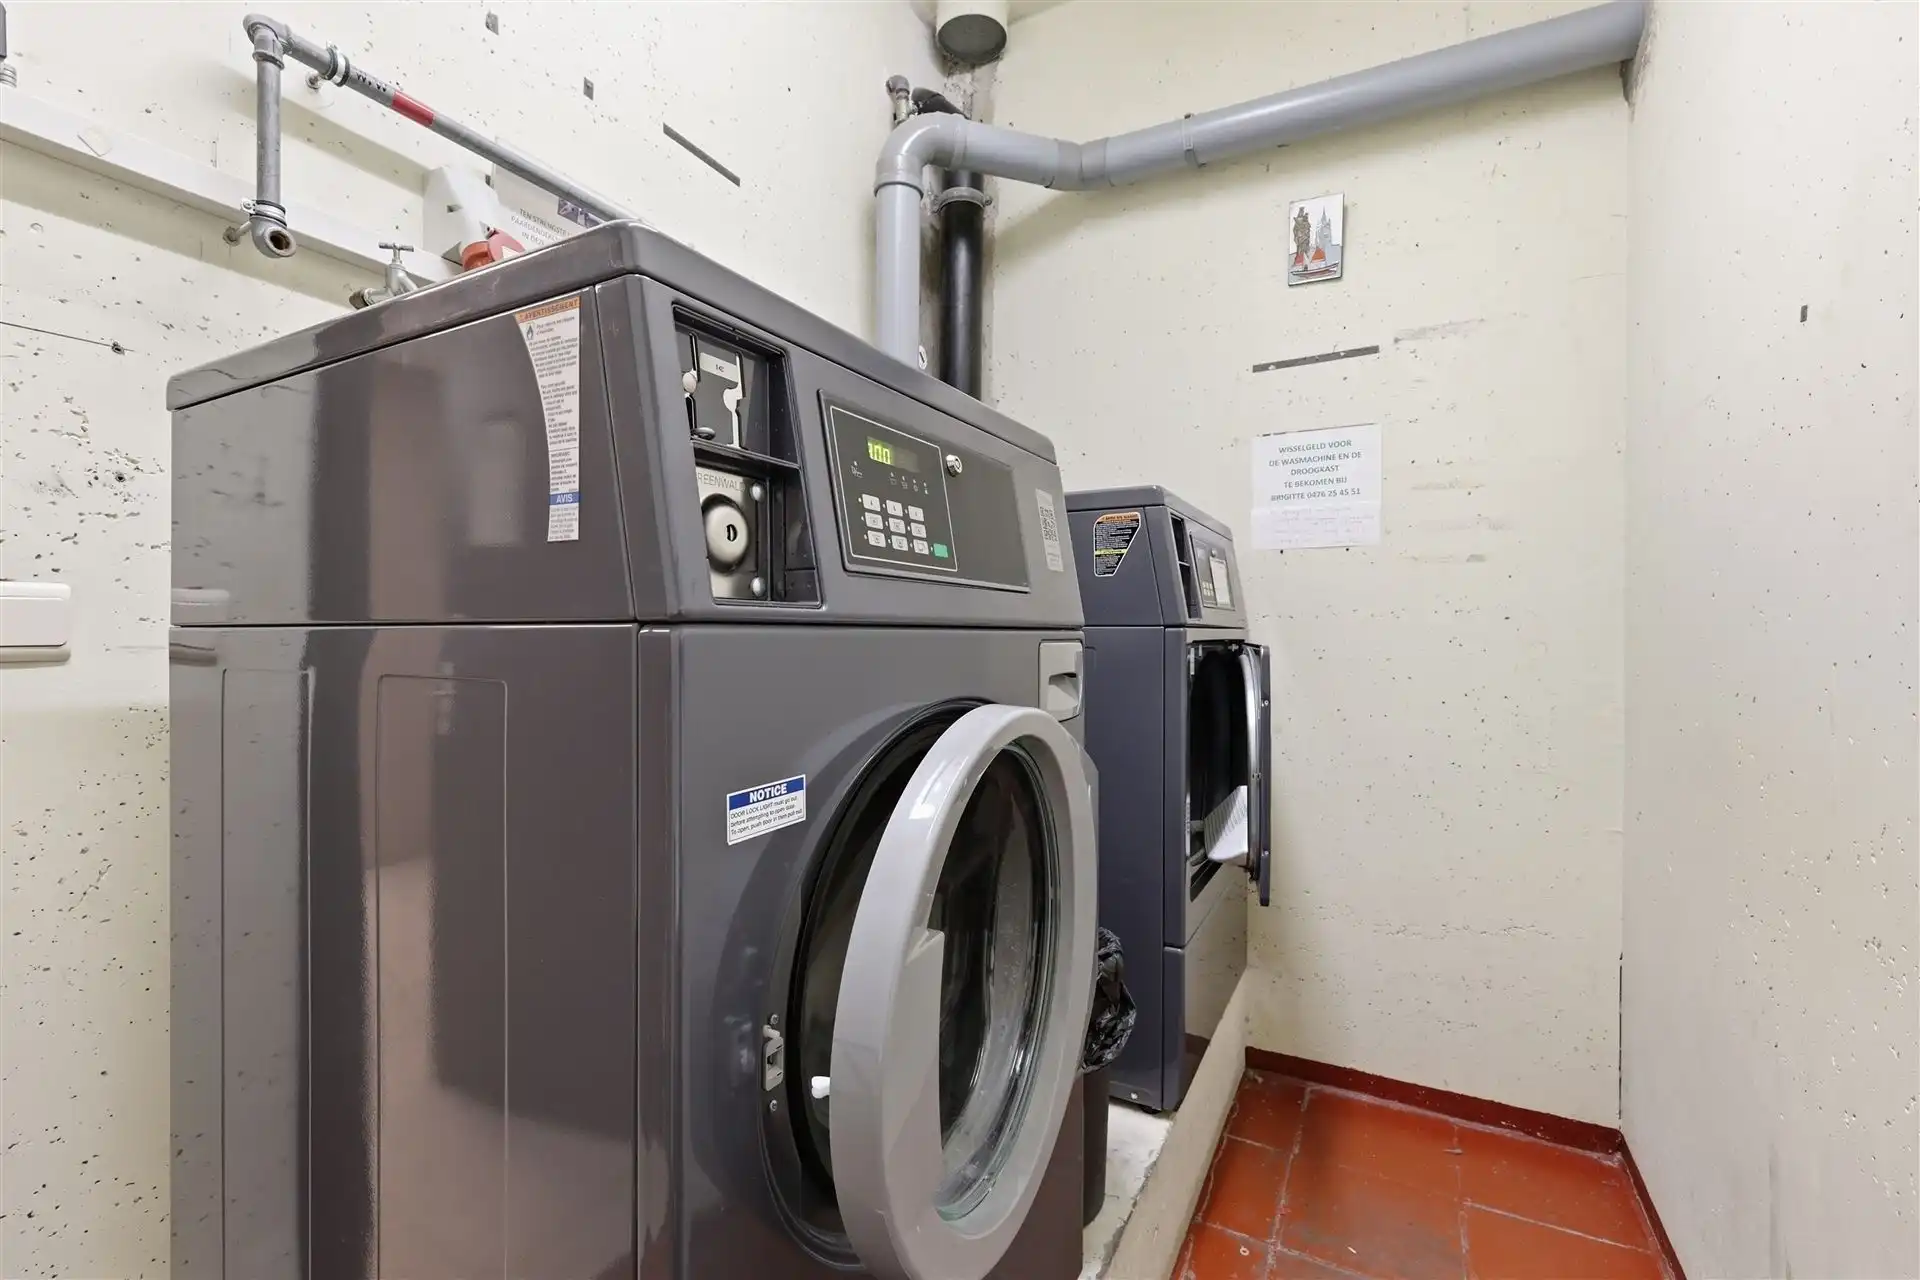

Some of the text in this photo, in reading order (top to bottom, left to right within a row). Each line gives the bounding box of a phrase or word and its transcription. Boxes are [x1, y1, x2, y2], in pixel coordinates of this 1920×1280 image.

[1278, 439, 1352, 454] WISSELGELD VOOR
[1268, 451, 1362, 467] DE WASMACHINE EN DE
[1290, 465, 1340, 476] DROOGKAST
[1284, 481, 1293, 489] TE
[1294, 476, 1334, 488] BEKOMEN
[555, 493, 573, 504] AVIS
[1270, 487, 1361, 502] BRIGITTE 0476 25 45 51
[749, 783, 788, 803] NOTICE
[730, 810, 746, 820] DOOR
[746, 807, 760, 816] LOCK
[760, 802, 773, 810] LIGHT
